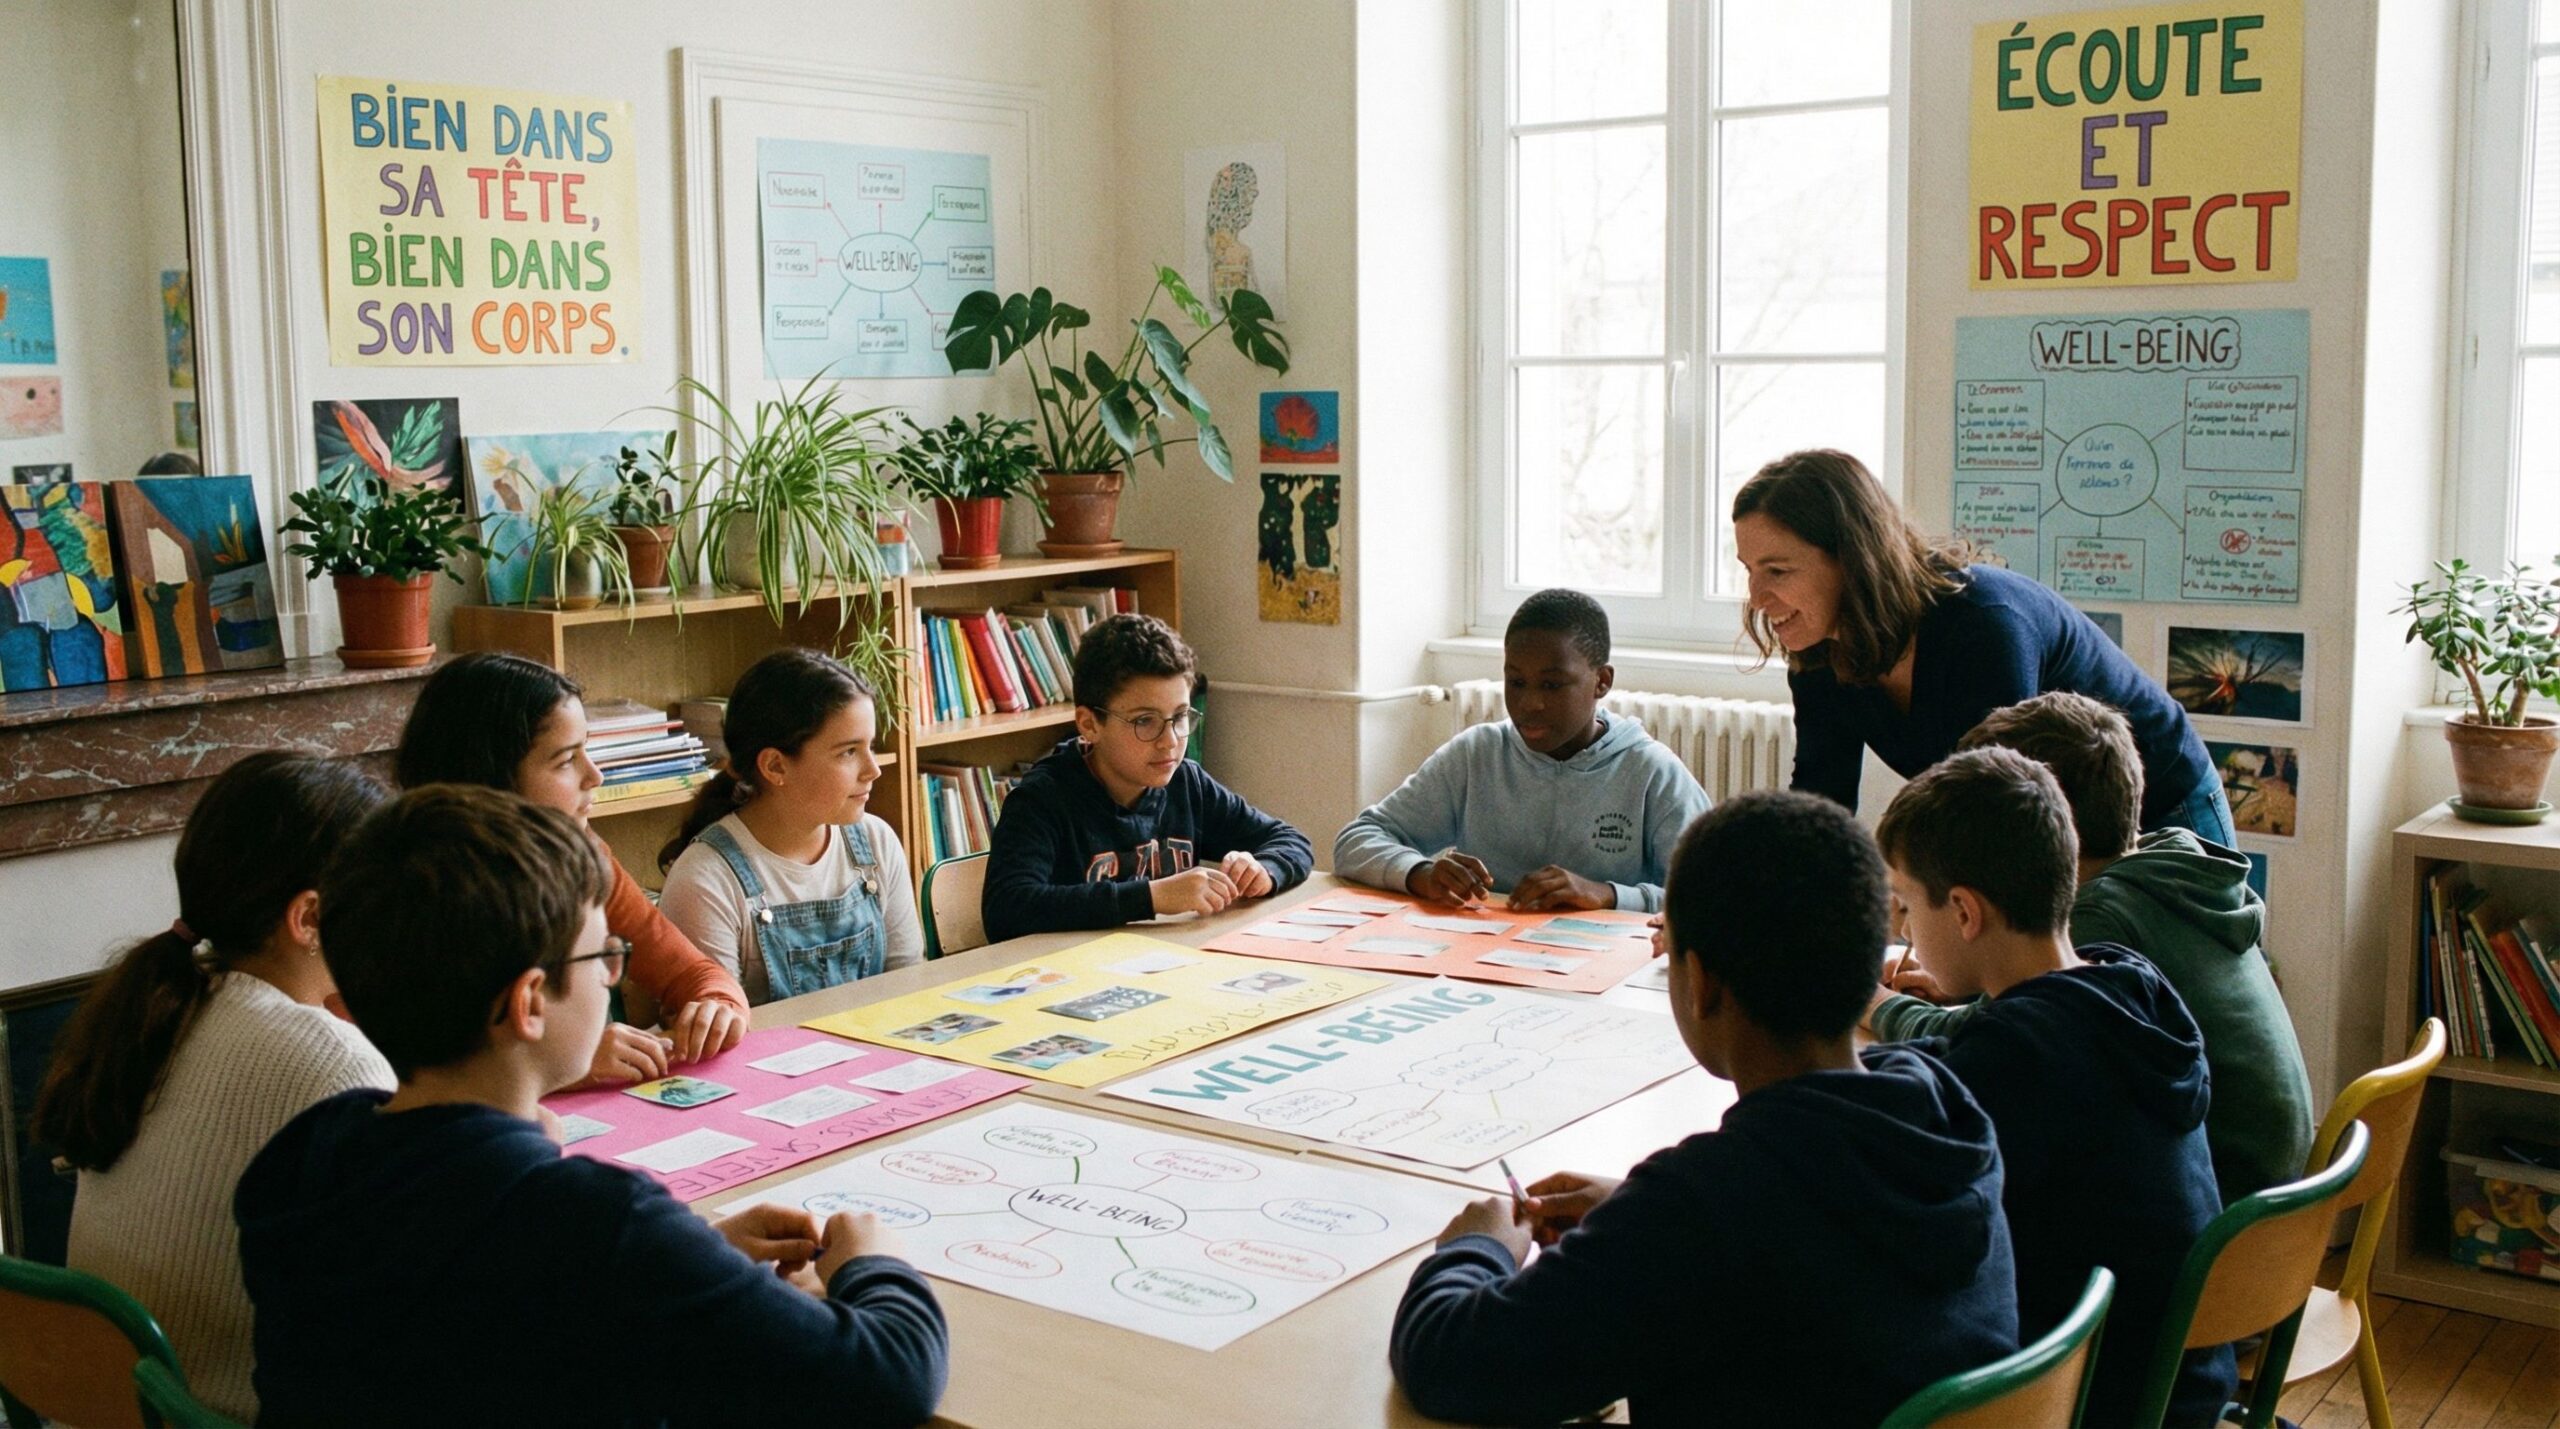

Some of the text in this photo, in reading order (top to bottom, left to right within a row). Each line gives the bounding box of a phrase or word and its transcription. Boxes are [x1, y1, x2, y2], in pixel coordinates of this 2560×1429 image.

[1997, 14, 2264, 111] ÉCOUTE
[493, 103, 613, 163] DANS
[2081, 110, 2168, 190] ET
[379, 157, 600, 232] SA TÊTE,
[491, 237, 611, 292] DANS
[840, 246, 919, 273] WELL-BEING
[1979, 190, 2290, 281] RESPECT
[357, 300, 629, 355] SON CORPS.
[2037, 322, 2233, 365] WELL-BEING
[1150, 986, 1497, 1102] WELL-BEING
[1027, 1188, 1175, 1231] WELL-BEING
